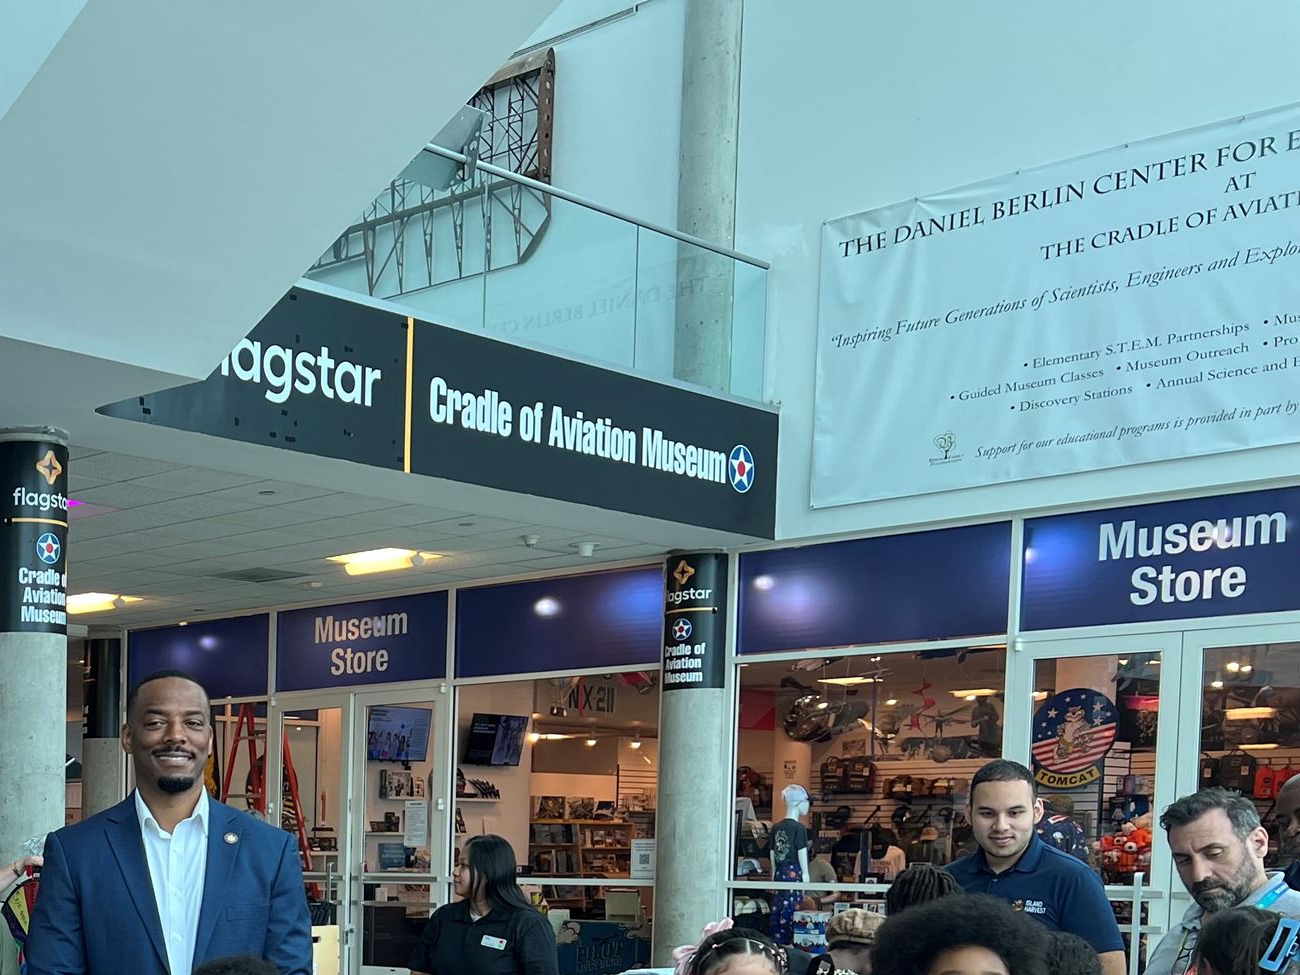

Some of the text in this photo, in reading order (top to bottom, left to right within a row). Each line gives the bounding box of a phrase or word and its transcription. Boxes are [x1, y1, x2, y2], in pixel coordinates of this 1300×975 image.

[839, 231, 887, 258] THE
[893, 206, 985, 245] DANIEL
[992, 180, 1086, 221] BERLIN
[1093, 152, 1208, 195] CENTER
[1215, 136, 1278, 168] FOR
[1224, 171, 1257, 194] AT
[1041, 237, 1085, 261] THE
[1091, 216, 1179, 249] CRADLE
[1186, 208, 1218, 229] OF
[895, 318, 941, 335] Future
[945, 299, 1028, 325] Generations
[1031, 290, 1048, 311] of
[1048, 279, 1119, 304] Scientists,
[1125, 262, 1203, 288] Engineers
[1207, 251, 1240, 272] and
[1032, 348, 1102, 369] Elementary
[1105, 335, 1162, 356] S.T.E.M.
[1167, 321, 1250, 346] Partnerships
[221, 337, 382, 408] agstar
[958, 384, 1001, 401] Guided
[1004, 376, 1057, 394] Museum
[1060, 368, 1104, 384] Classes
[1125, 355, 1182, 373] Museum
[1186, 341, 1249, 362] Outreach
[1019, 394, 1080, 412] Discovery
[1083, 384, 1133, 402] Stations
[1155, 372, 1204, 390] Annual
[1207, 364, 1258, 381] Science
[1262, 357, 1288, 372] and
[429, 376, 727, 484] Cradle of Aviation Museum
[974, 442, 1017, 460] Support
[1018, 440, 1034, 454] for
[1035, 437, 1054, 450] our
[1056, 425, 1119, 446] educational
[1117, 420, 1170, 441] programs
[1173, 416, 1185, 430] is
[1185, 407, 1237, 431] provided
[1238, 406, 1252, 419] in
[1253, 403, 1282, 422] part
[1285, 400, 1299, 415] by
[12, 487, 69, 511] flagsta
[1098, 511, 1287, 562] Museum
[18, 567, 61, 587] Cradle
[1130, 565, 1247, 606] Store
[314, 611, 408, 644] Museum
[331, 649, 389, 676] Store
[664, 642, 706, 658] Cradle of
[665, 657, 702, 671] Aviation
[664, 671, 703, 684] Museum
[1039, 769, 1095, 786] TOMCAT
[1024, 906, 1047, 914] HARVEST
[1025, 900, 1044, 908] ISLAND
